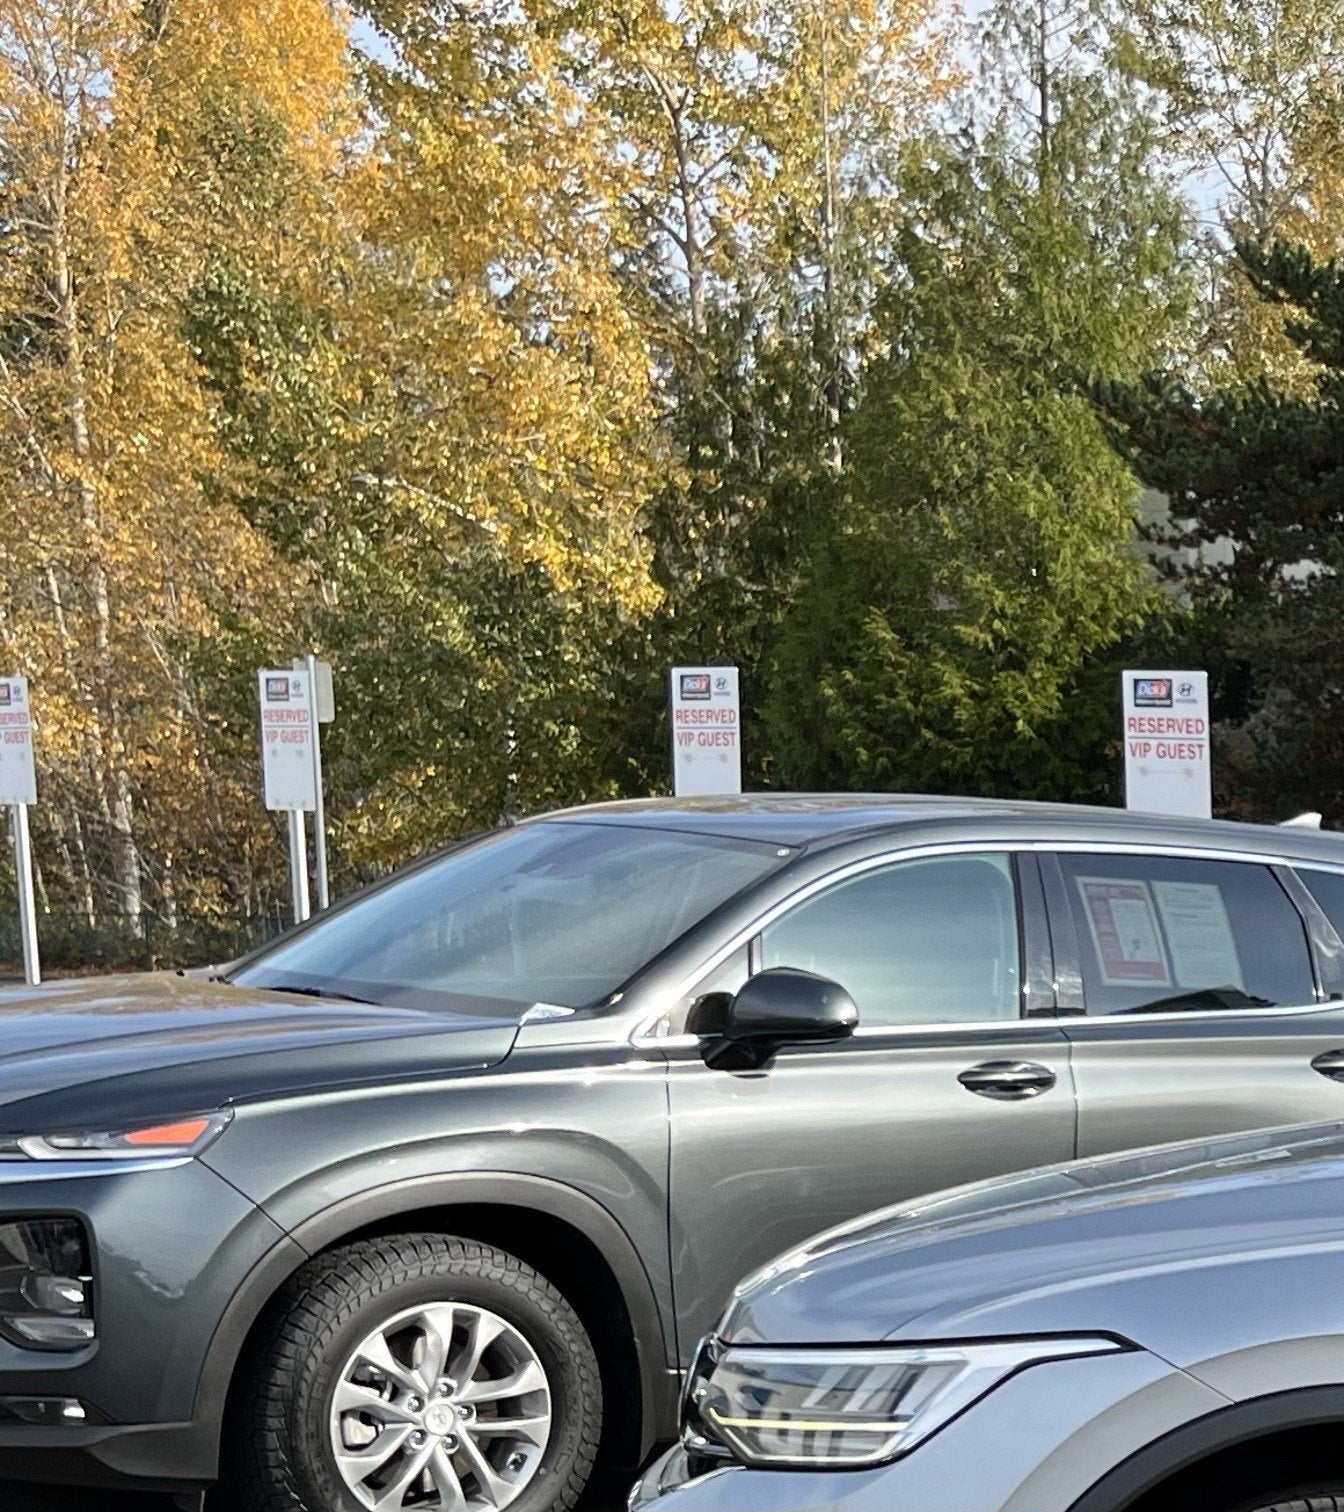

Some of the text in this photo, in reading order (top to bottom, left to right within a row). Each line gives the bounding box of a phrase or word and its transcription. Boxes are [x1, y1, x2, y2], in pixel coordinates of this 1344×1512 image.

[263, 708, 309, 723] RESERVED
[675, 709, 737, 724] RESERVED
[1127, 716, 1205, 734] RESERVED
[281, 729, 309, 743] GUEST
[677, 731, 736, 747] VIP GUEST
[1128, 742, 1205, 760] VIP GUEST
